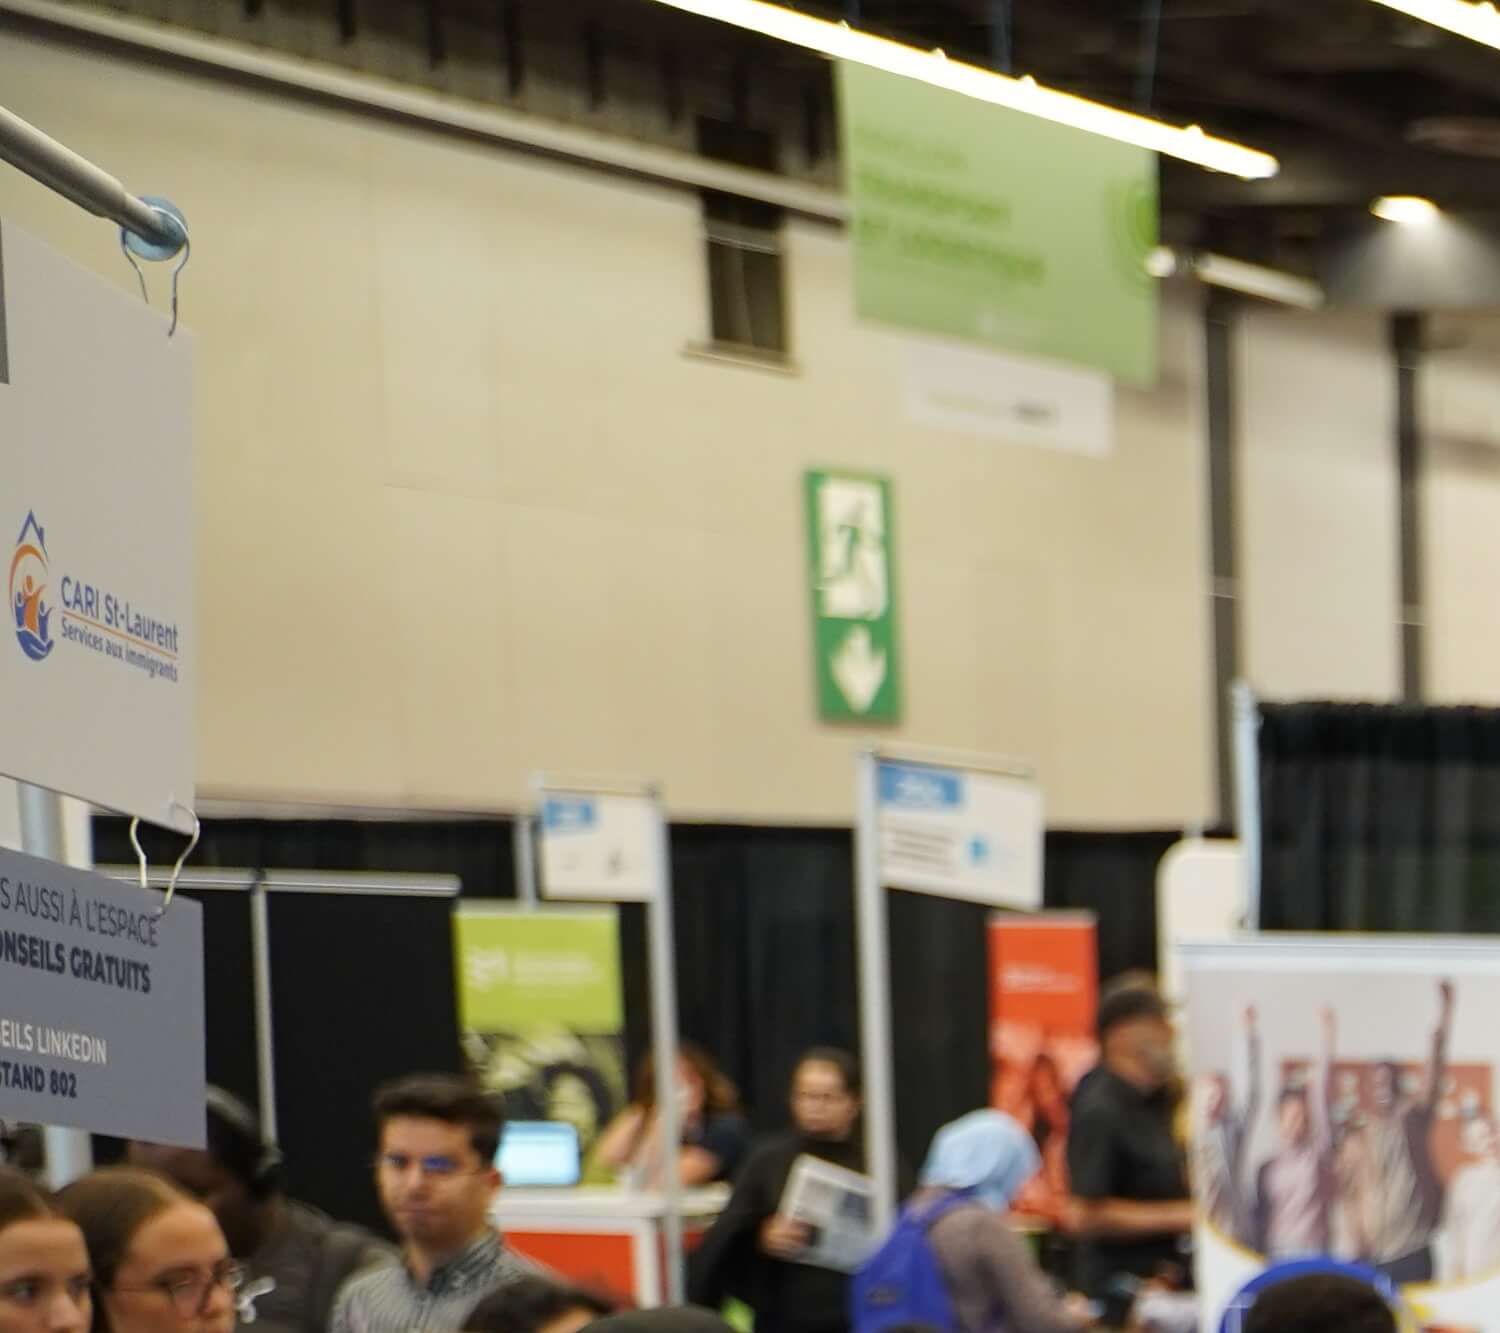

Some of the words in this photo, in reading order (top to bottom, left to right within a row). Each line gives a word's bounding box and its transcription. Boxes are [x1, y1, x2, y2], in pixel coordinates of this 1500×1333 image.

[61, 576, 99, 619] CARI
[105, 594, 178, 653] St-Laurent
[62, 616, 102, 651] Services
[106, 638, 123, 659] aux
[126, 646, 178, 682] immigrants
[14, 882, 65, 925] AUSSI
[70, 888, 82, 928] À
[86, 899, 158, 947] L'ESPACE
[71, 946, 150, 993] GRATUITS
[37, 1027, 107, 1064] LINKEDIN
[50, 1069, 77, 1098] 802
